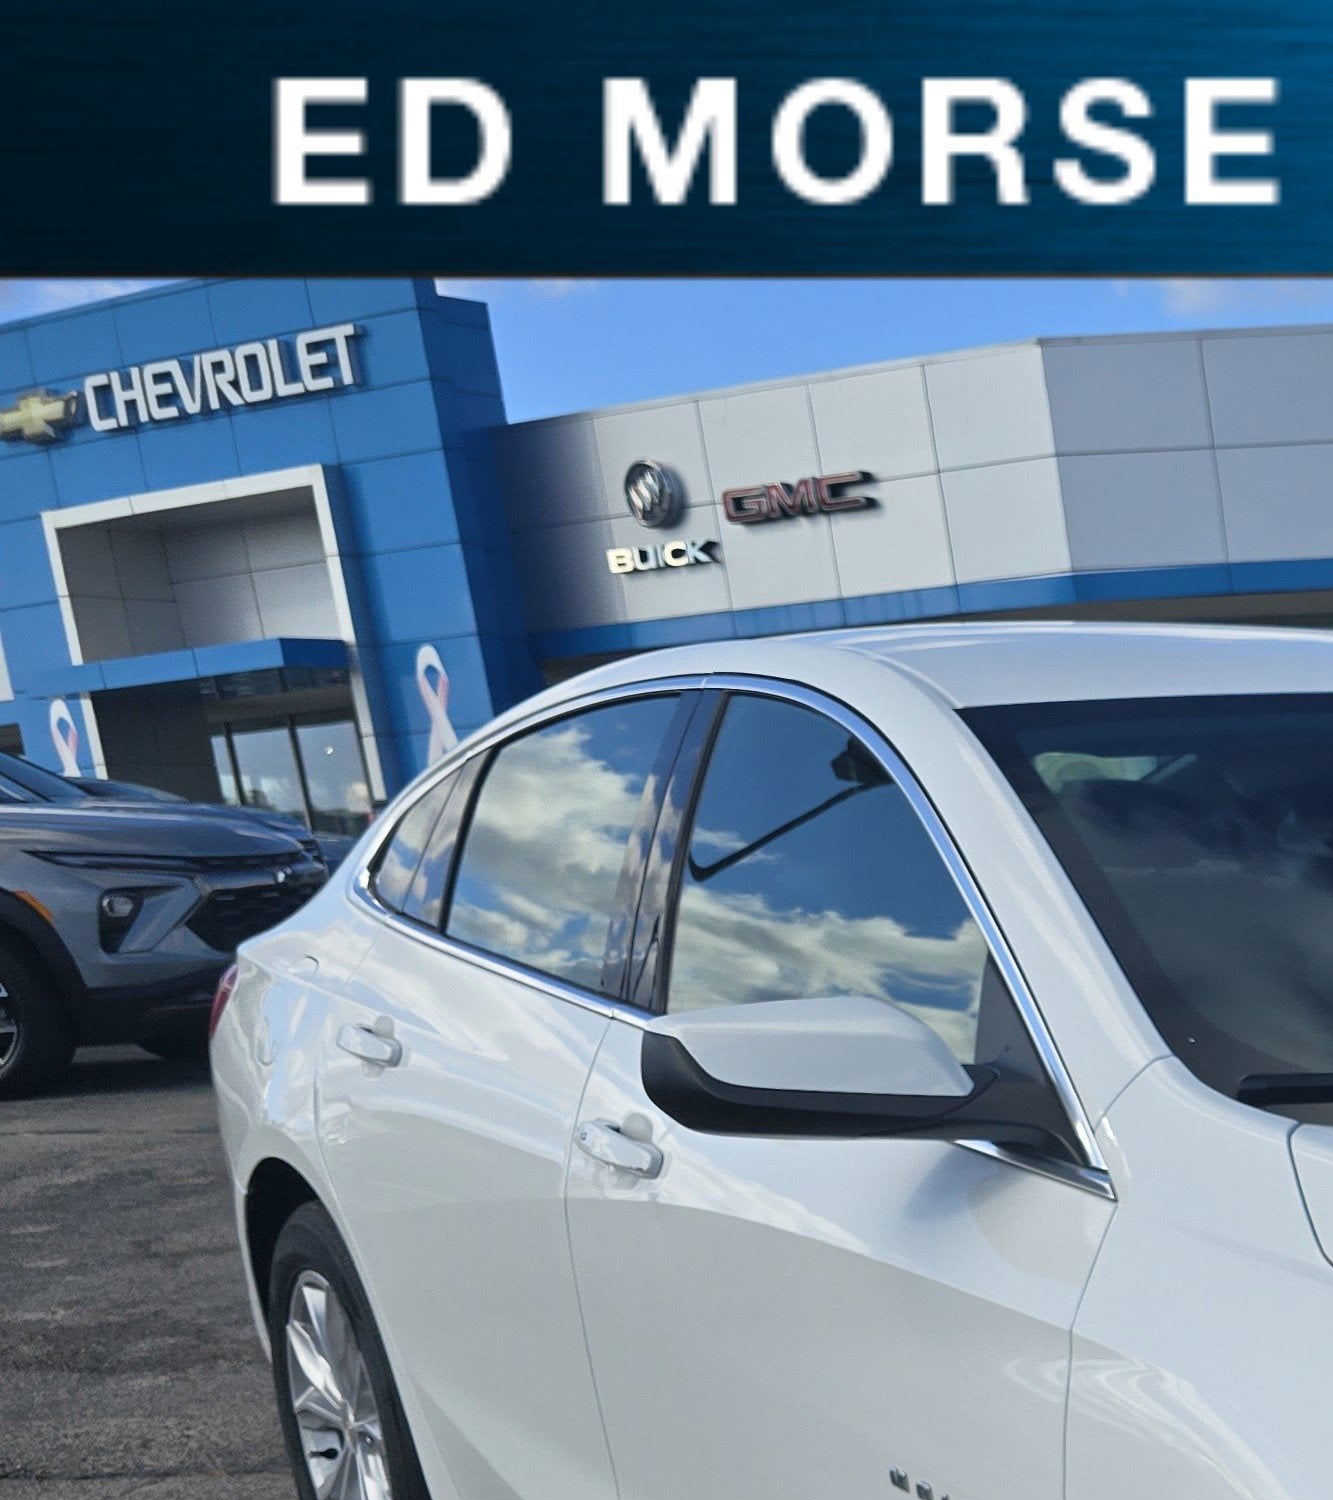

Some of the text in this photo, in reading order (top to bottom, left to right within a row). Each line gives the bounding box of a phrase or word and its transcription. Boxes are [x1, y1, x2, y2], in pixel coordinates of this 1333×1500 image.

[84, 322, 356, 433] CHEVROLET
[721, 471, 866, 525] GMC
[606, 540, 713, 574] BUICK
